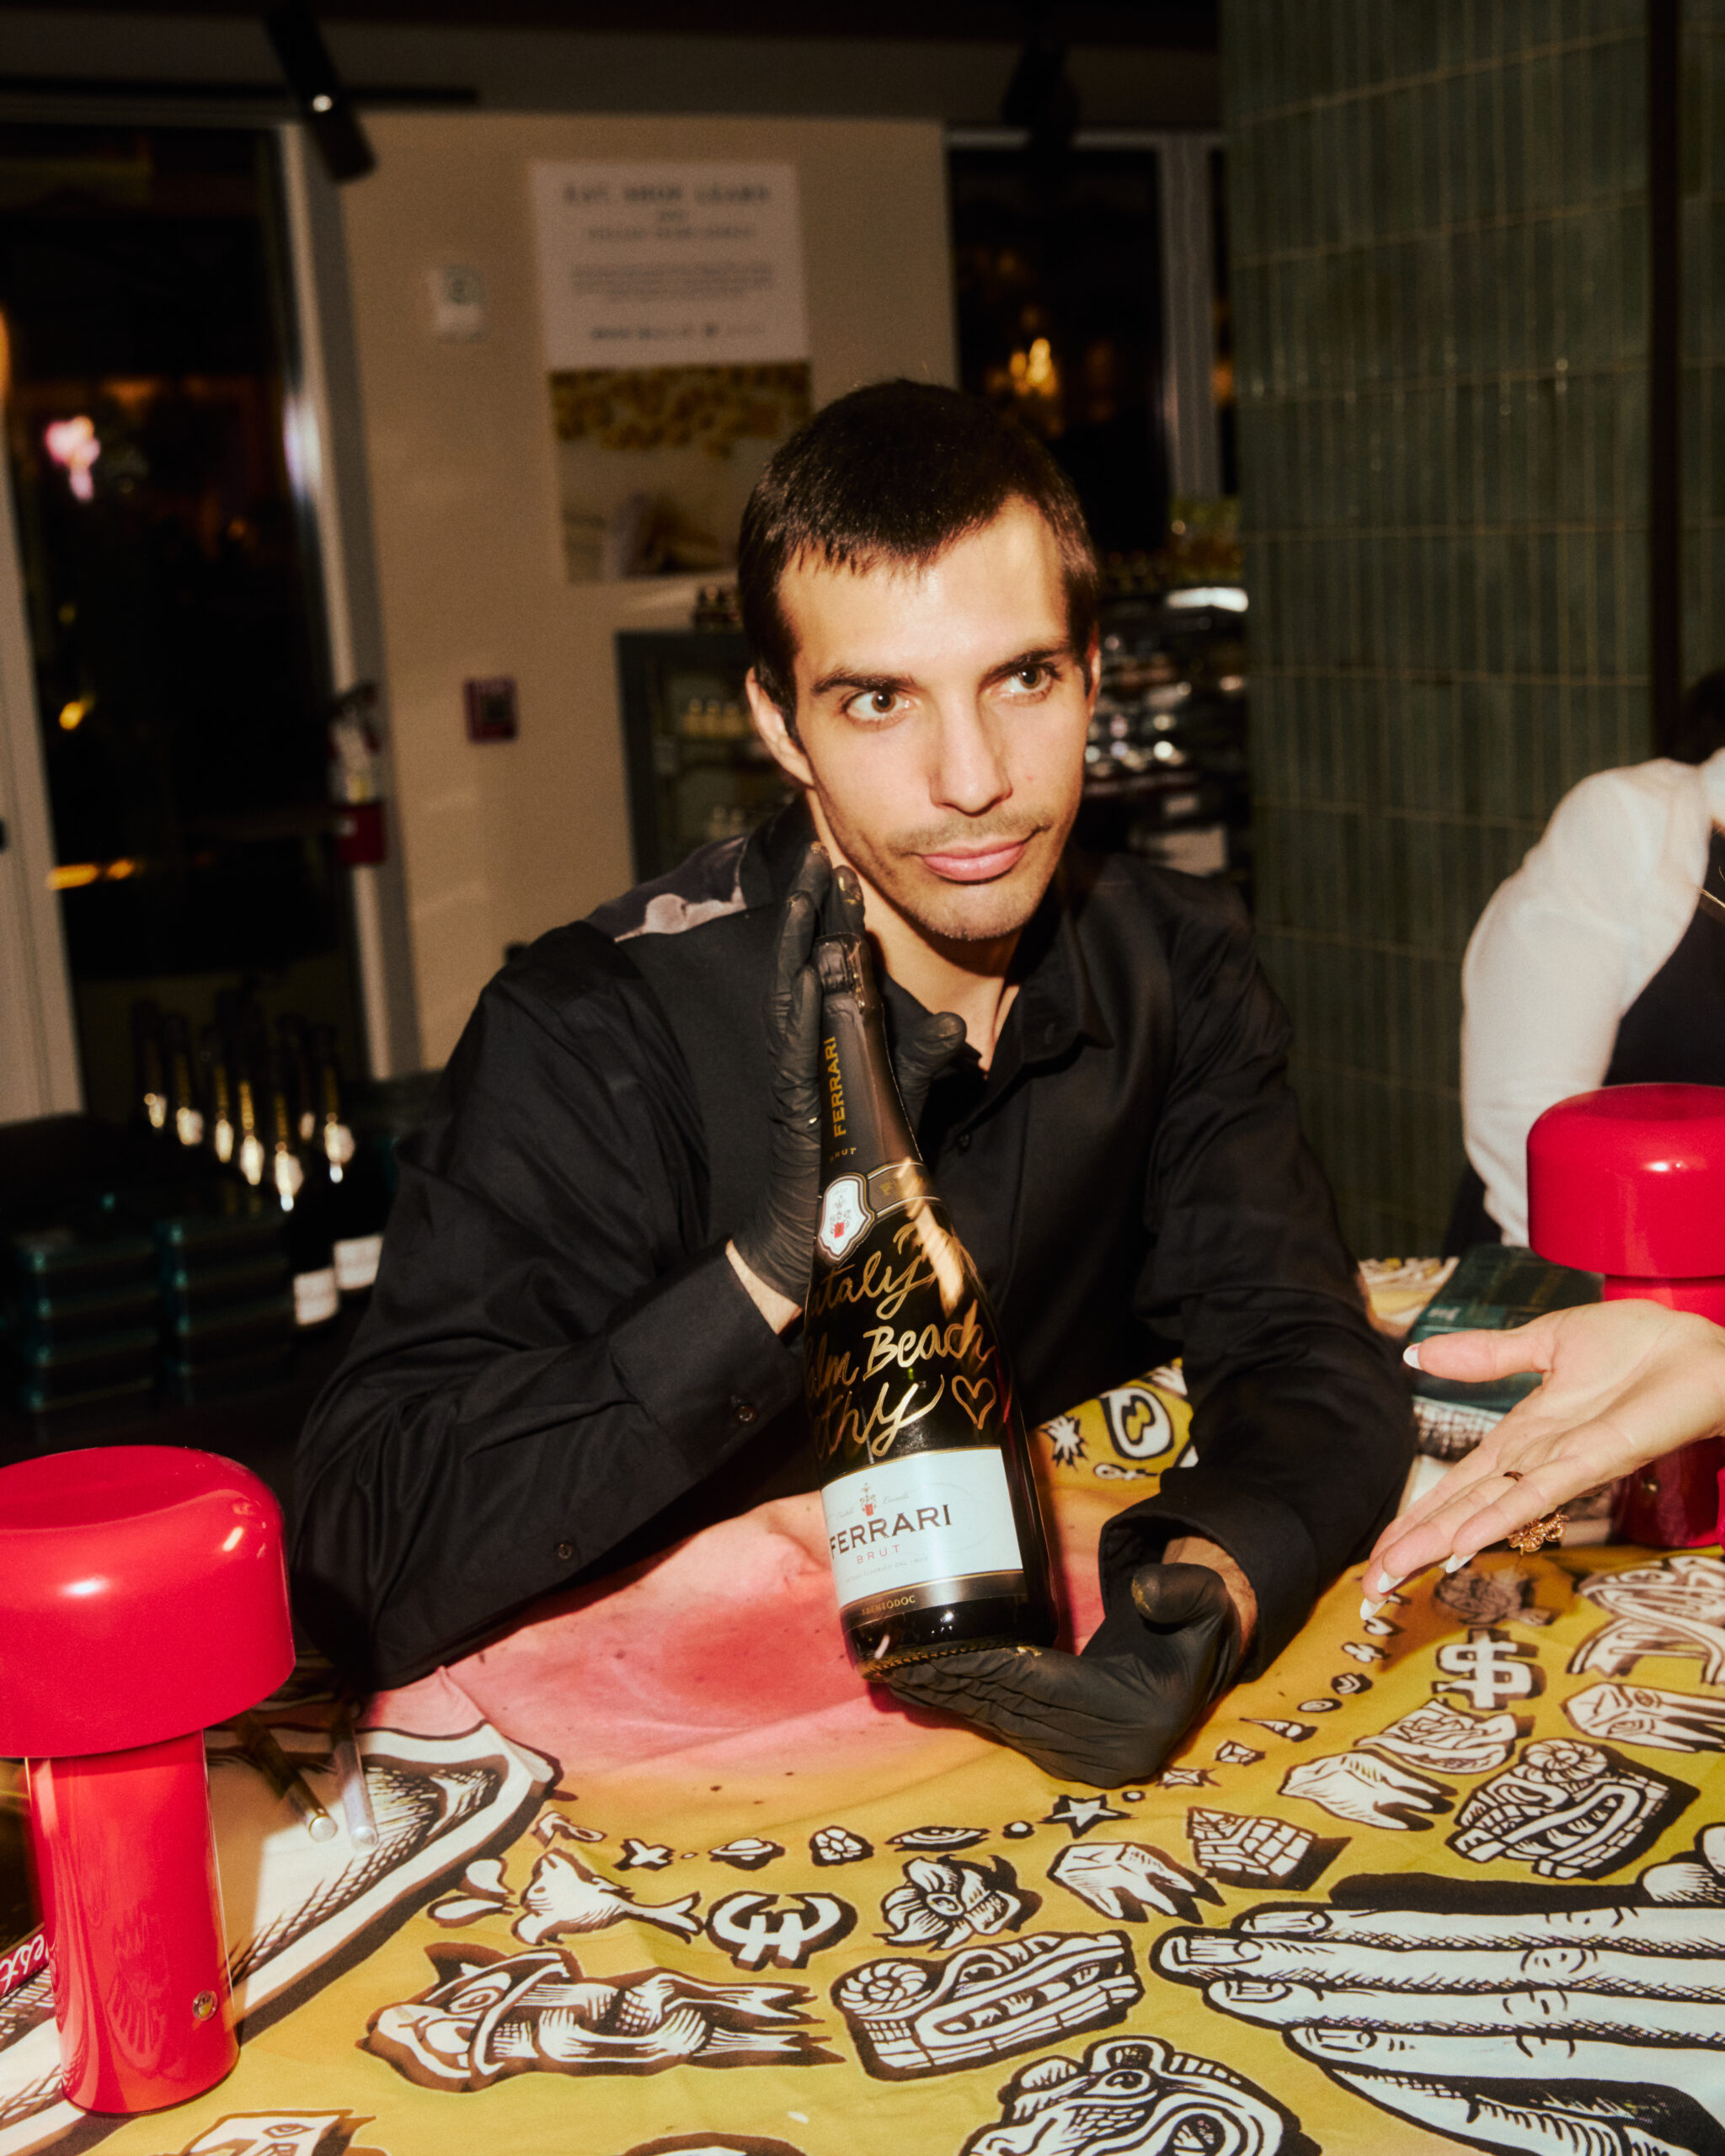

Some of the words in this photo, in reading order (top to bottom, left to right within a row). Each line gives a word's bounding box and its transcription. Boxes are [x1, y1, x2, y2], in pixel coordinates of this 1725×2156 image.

[823, 1036, 847, 1138] FERRARI
[830, 1147, 857, 1164] BRUT
[862, 1299, 996, 1382] Beach
[829, 1504, 953, 1561] FERRARI
[856, 1544, 900, 1565] BRUT
